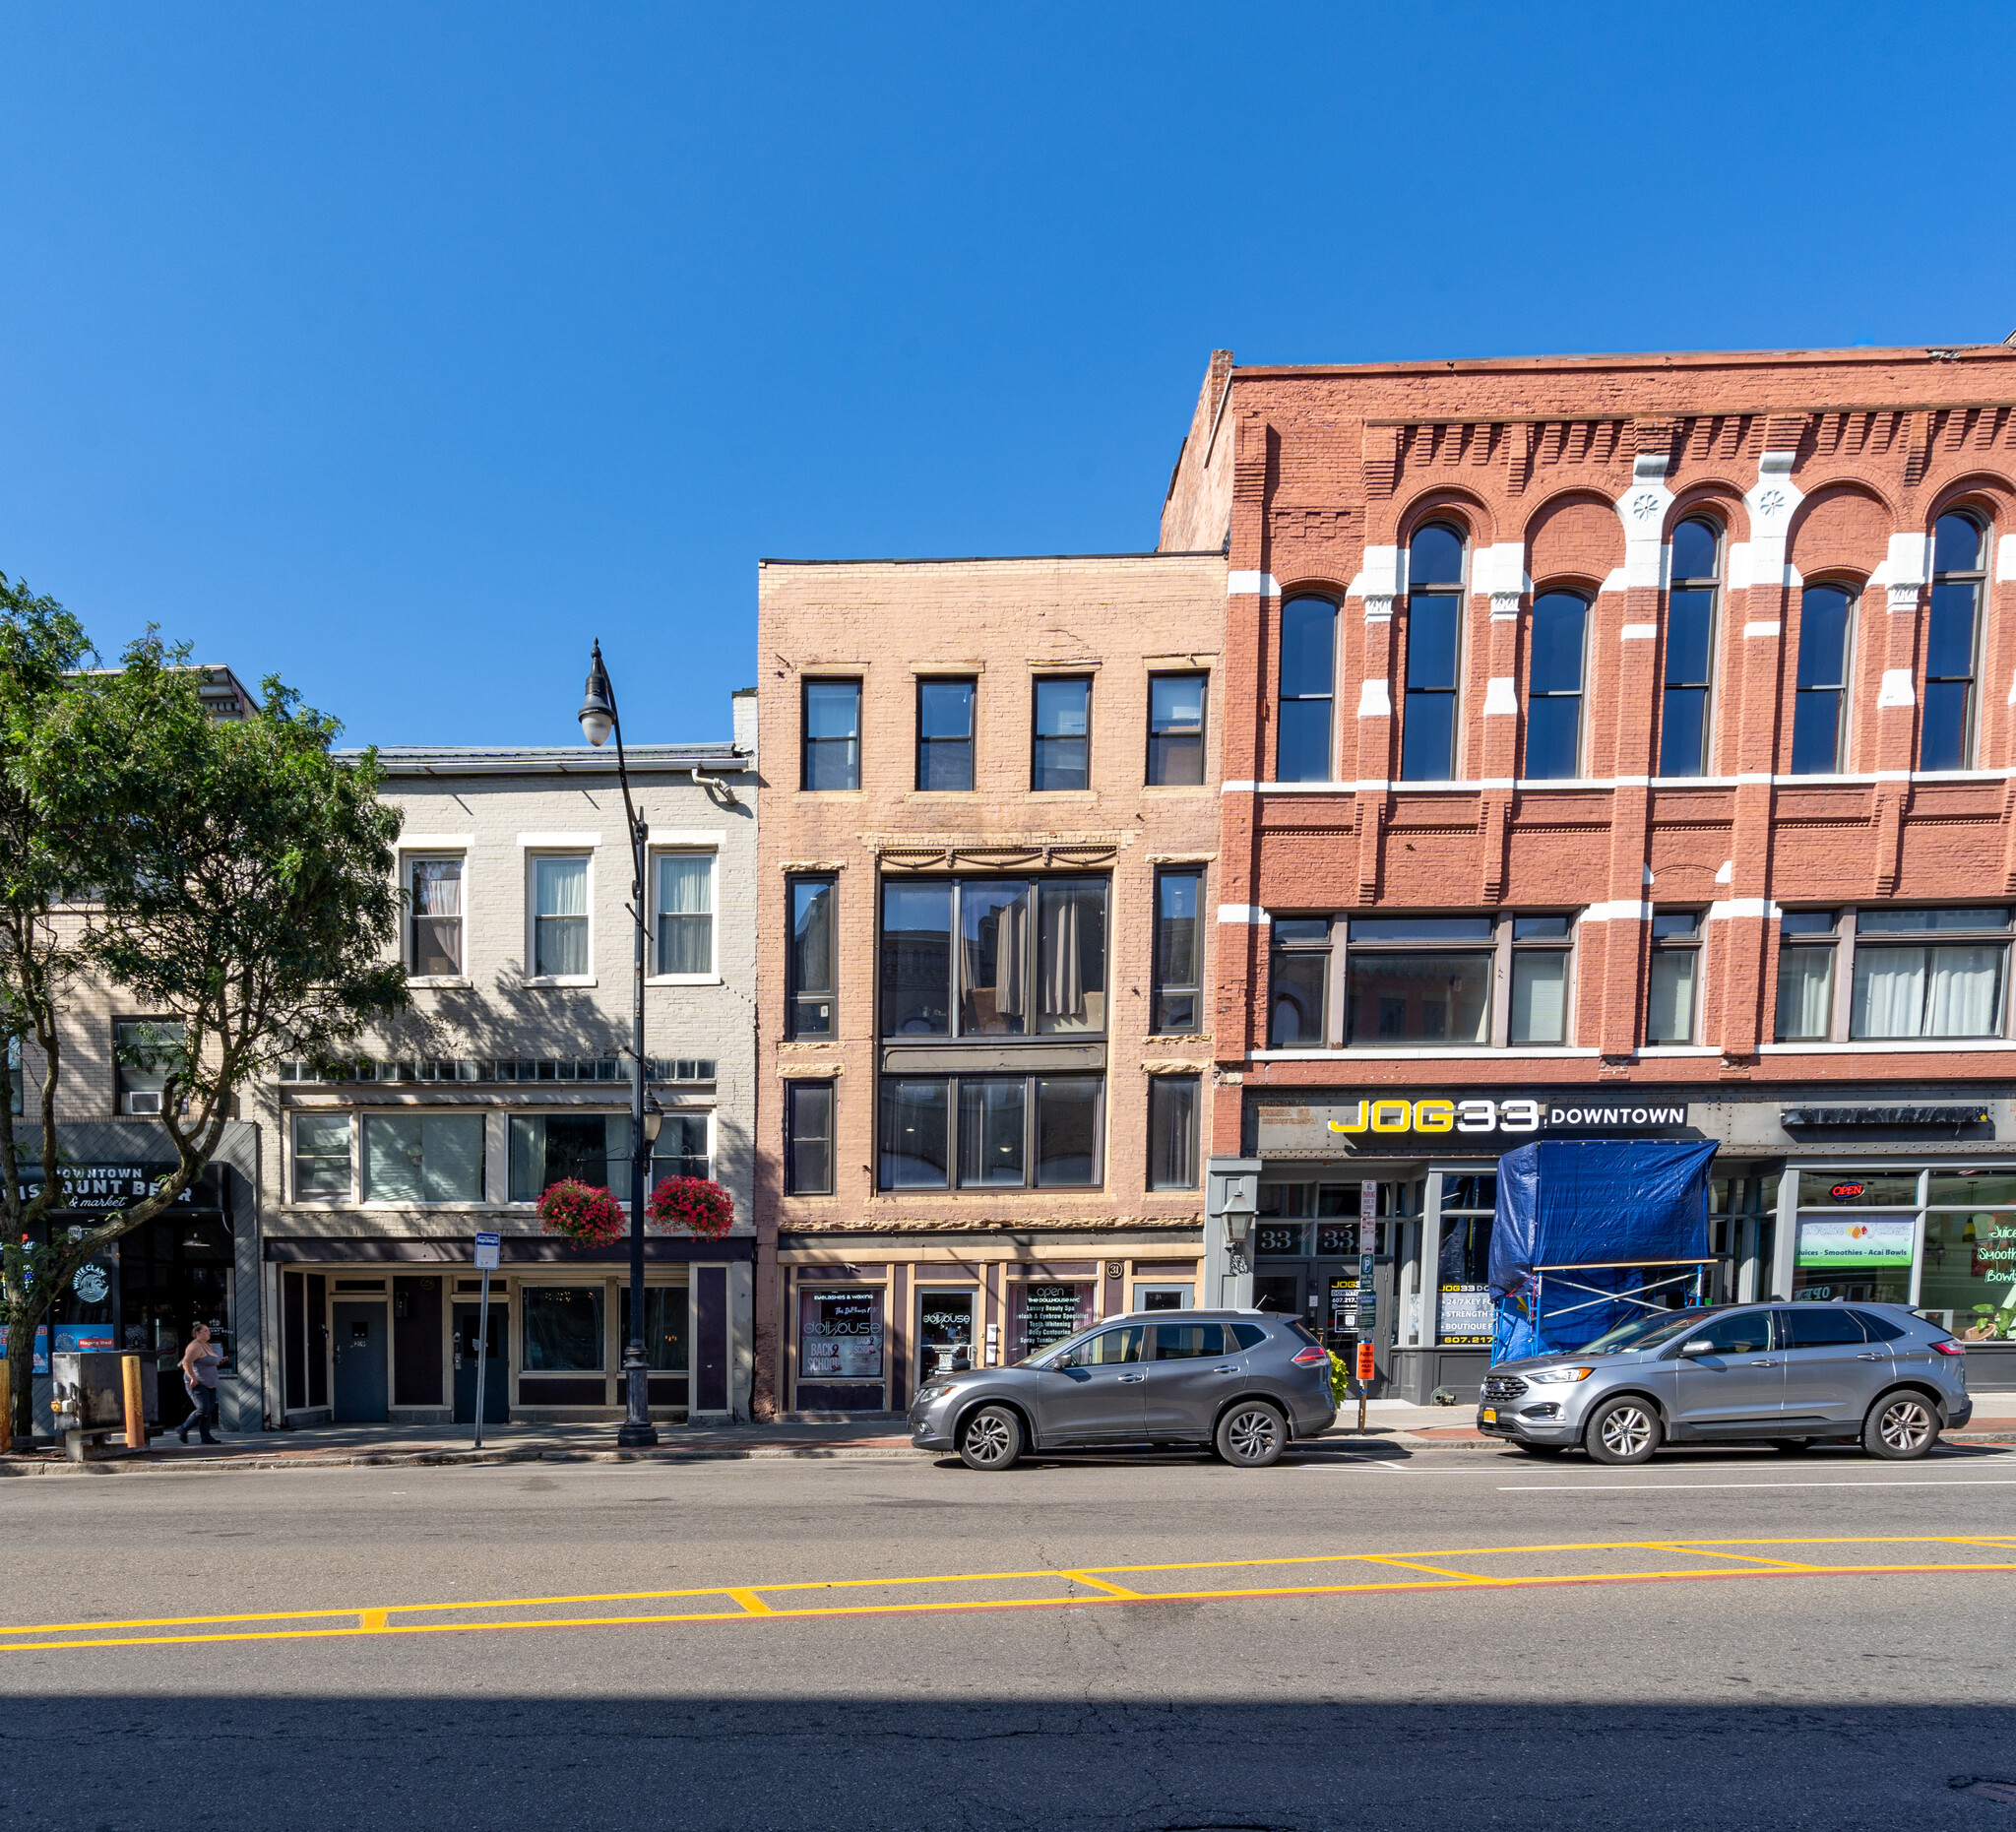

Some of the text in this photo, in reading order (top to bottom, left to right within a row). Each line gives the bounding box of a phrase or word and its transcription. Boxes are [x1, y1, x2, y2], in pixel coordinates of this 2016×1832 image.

[1328, 1100, 1684, 1133] JOG33 DOWNTOWN
[132, 1181, 192, 1202] BER
[1832, 1185, 1862, 1196] OPEN
[69, 1195, 129, 1207] & market
[1261, 1231, 1292, 1249] 33
[1110, 1265, 1118, 1274] 31
[73, 1264, 107, 1290] WHITE CLAW
[1037, 1288, 1064, 1297] open
[811, 1343, 834, 1357] BACK
